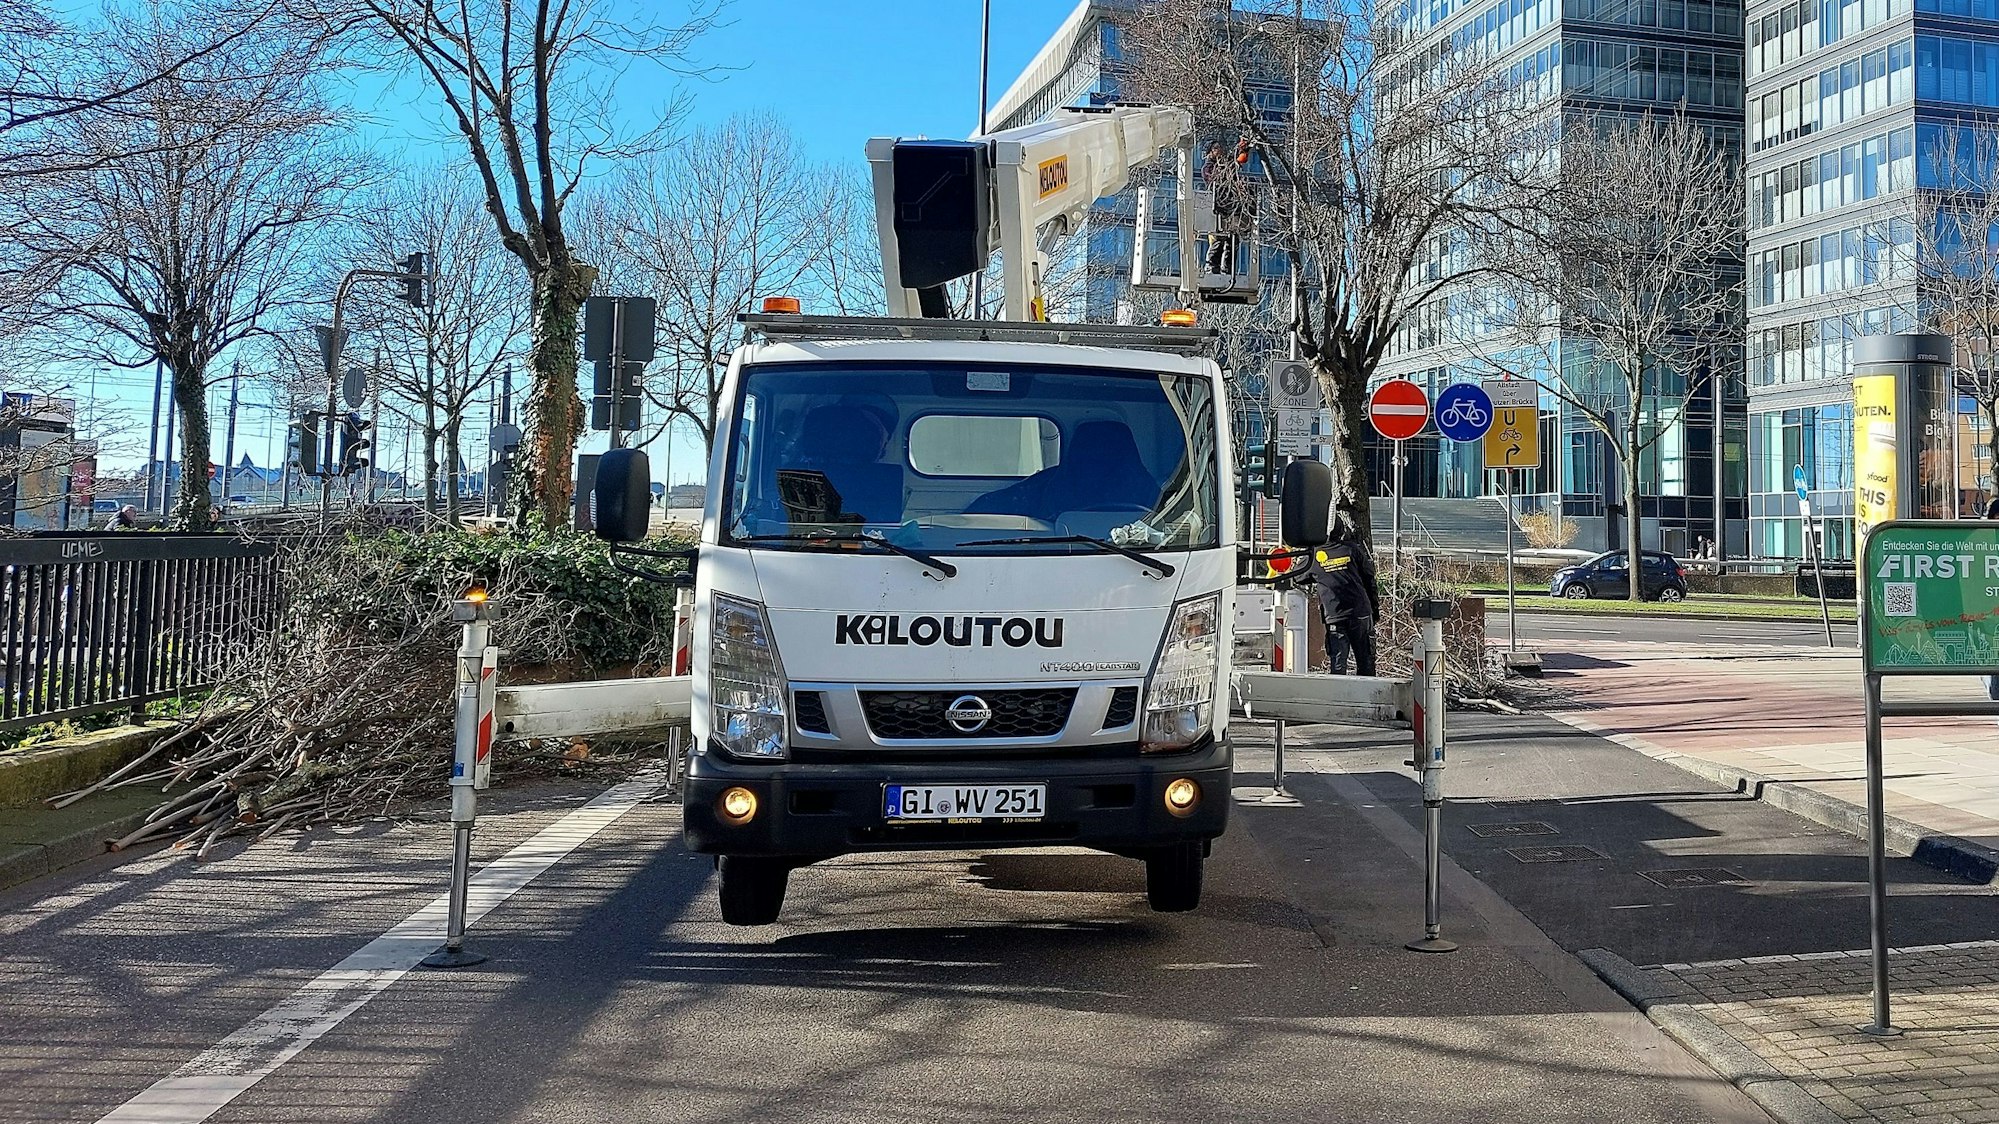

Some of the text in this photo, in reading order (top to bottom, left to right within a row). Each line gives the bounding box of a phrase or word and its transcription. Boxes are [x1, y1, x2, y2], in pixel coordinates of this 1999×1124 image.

[1504, 410, 1515, 425] U
[1867, 472, 1888, 483] yfood
[1860, 487, 1885, 506] THIS
[1882, 540, 1925, 551] Entdecken
[1926, 540, 1940, 551] Sie
[1941, 541, 1954, 551] die
[1955, 541, 1974, 552] Welt
[1975, 541, 1988, 551] mit
[1876, 554, 1975, 578] FIRST
[1040, 662, 1094, 672] NT400
[950, 710, 987, 719] NISSAN
[902, 788, 1042, 815] GI WV 251
